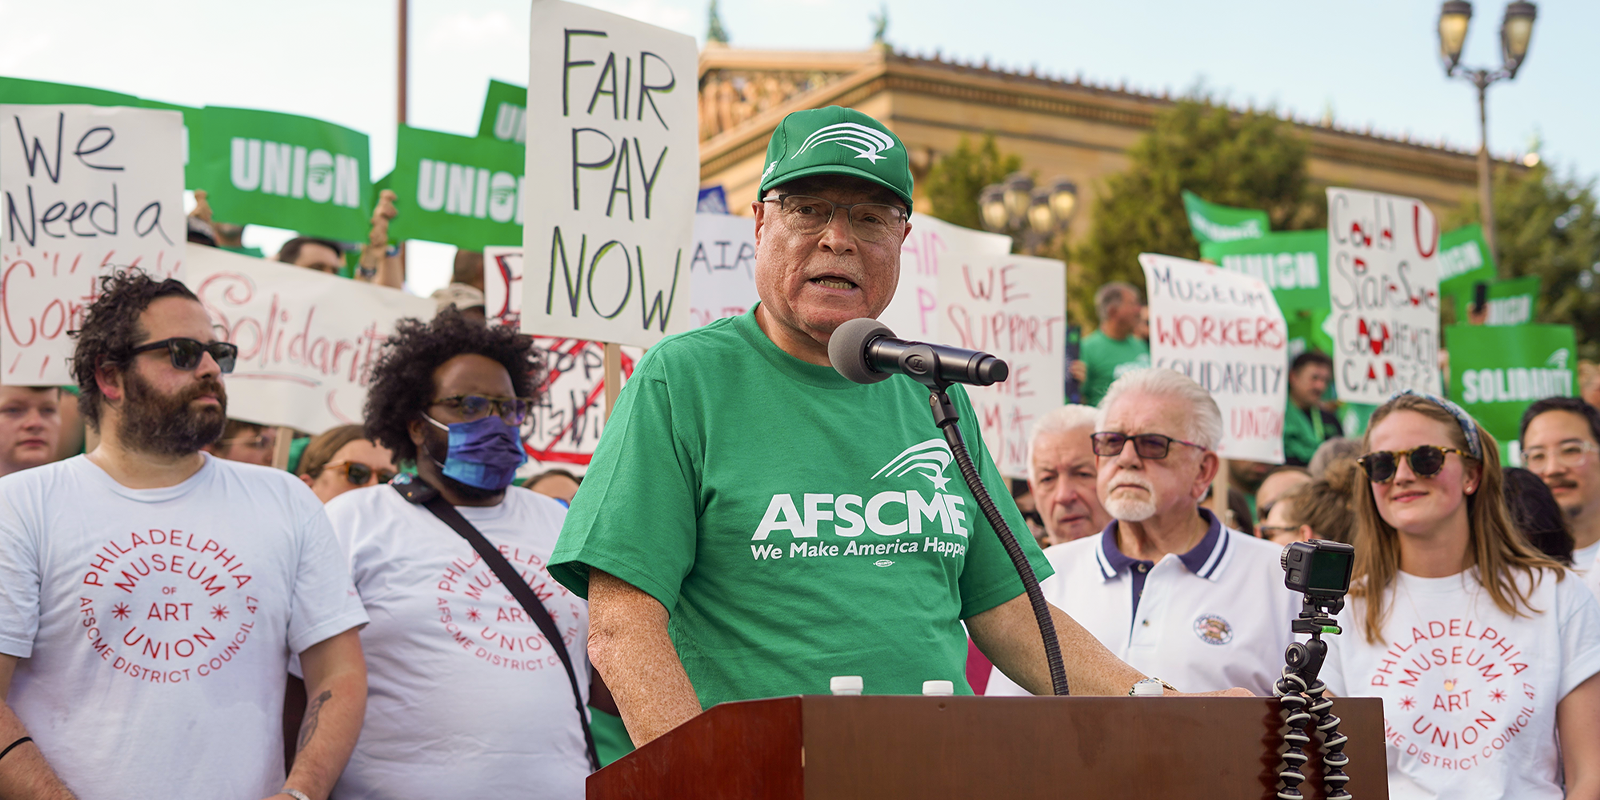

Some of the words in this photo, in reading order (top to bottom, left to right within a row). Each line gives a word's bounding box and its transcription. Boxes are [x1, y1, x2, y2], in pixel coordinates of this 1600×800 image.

[563, 28, 676, 131] FAIR
[15, 112, 125, 183] We
[230, 137, 361, 209] UNION
[572, 127, 668, 221] PAY
[6, 183, 118, 247] Need
[134, 202, 174, 245] a
[1412, 204, 1440, 259] U
[546, 225, 682, 333] NOW
[690, 240, 757, 281] AIR
[962, 263, 1030, 304] WE
[2, 259, 103, 348] Cont
[1153, 266, 1269, 314] MUSEUM
[197, 270, 390, 388] Solidarit
[947, 303, 1065, 355] SUPPORT
[1156, 314, 1287, 350] WORKERS
[1461, 367, 1574, 404] SOLIDARITY
[750, 489, 969, 541] AFSCME
[83, 528, 253, 590] PHILADELPHIA
[750, 543, 783, 560] We
[789, 541, 839, 558] Make
[843, 538, 919, 556] America
[923, 536, 966, 558] Happe
[114, 553, 227, 597] MUSEUM
[161, 586, 178, 595] OF
[147, 602, 194, 622] ART
[437, 596, 476, 650] AFSCME
[475, 647, 544, 671] DISTRICT
[79, 596, 115, 661] AFSCME
[112, 655, 191, 684] DISTRICT
[196, 620, 256, 677] COUNCIL
[246, 594, 259, 615] 47
[123, 625, 217, 661] UNION
[1371, 618, 1529, 688] PHILADELPHIA
[1398, 646, 1503, 687] MUSEUM
[1406, 742, 1479, 771] DISTRICT
[1481, 706, 1536, 759] COUNCIL
[1522, 682, 1536, 700] 47
[1432, 689, 1472, 712] ART
[1412, 710, 1497, 750] UNION
